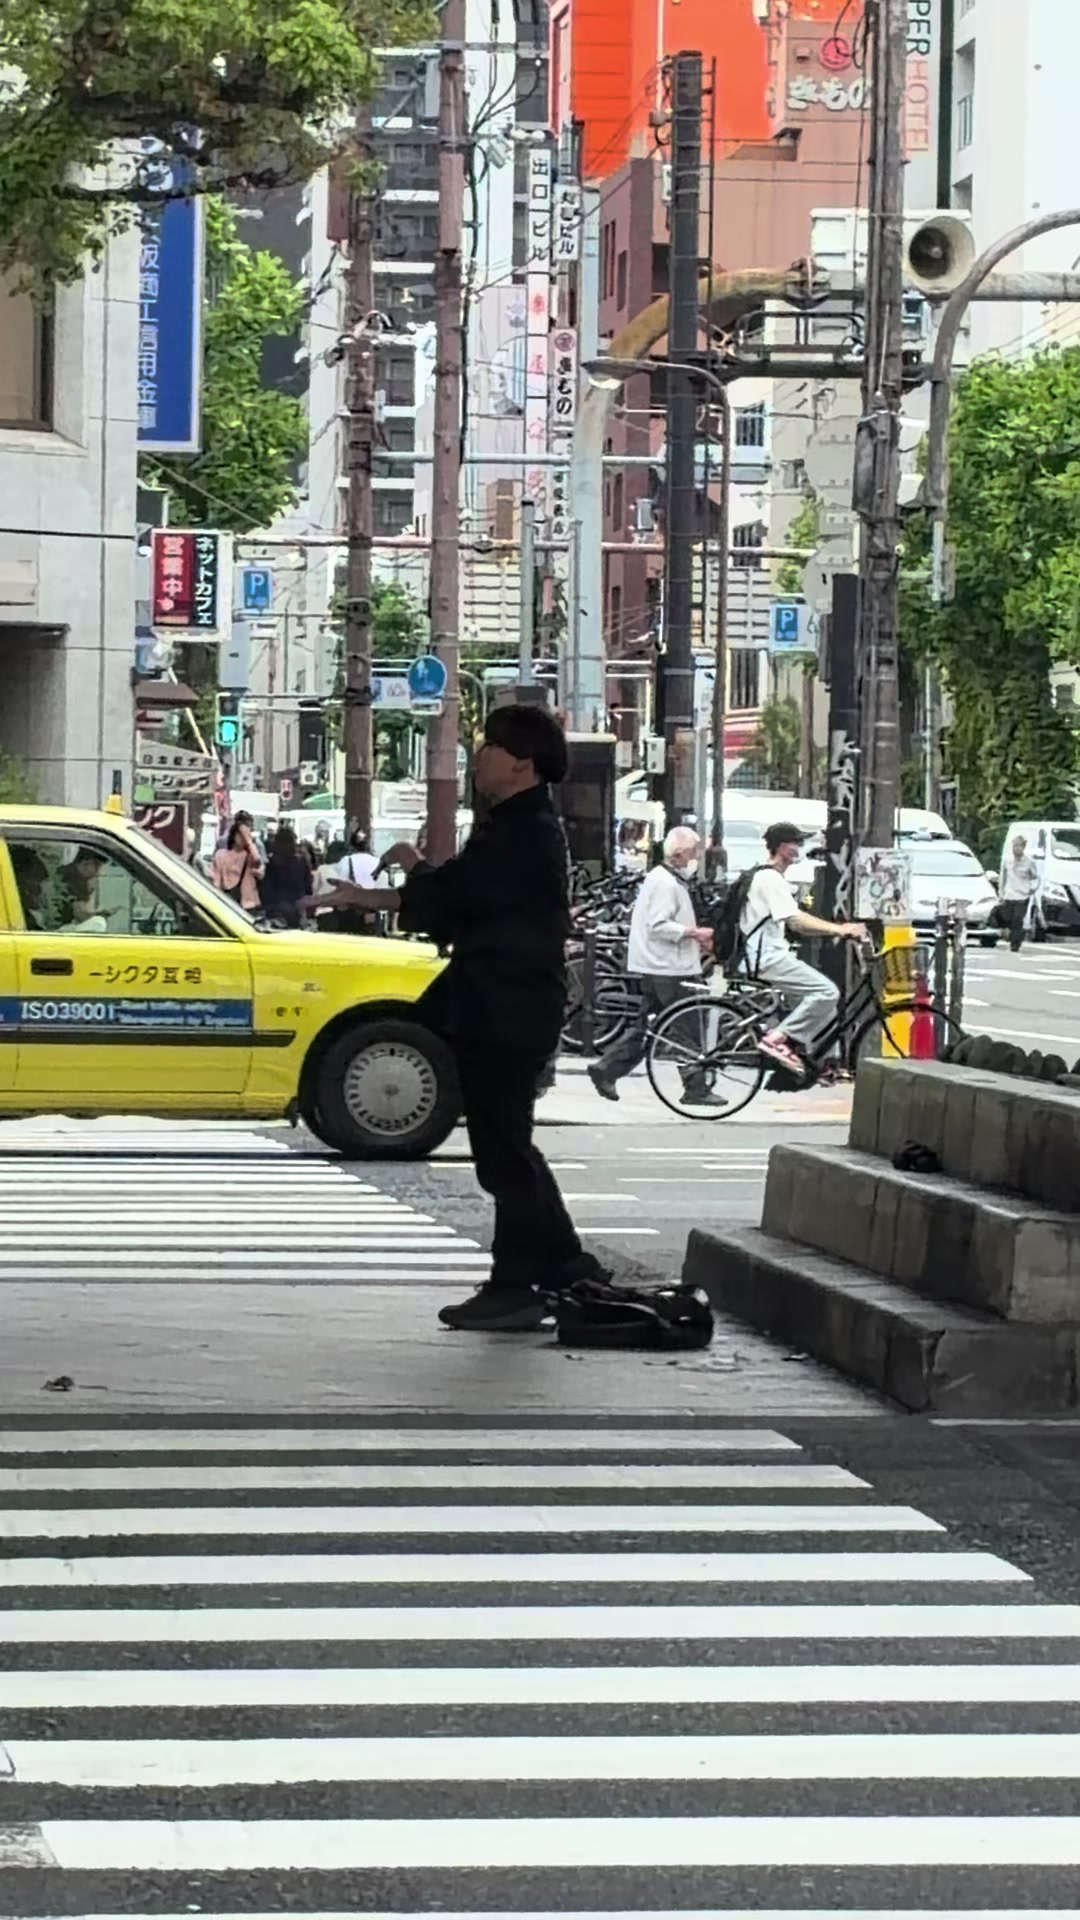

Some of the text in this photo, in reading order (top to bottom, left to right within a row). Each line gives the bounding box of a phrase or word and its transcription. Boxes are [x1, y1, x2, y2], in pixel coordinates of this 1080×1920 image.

[138, 213, 161, 429] 阪商工信用金庫
[250, 573, 265, 595] P
[781, 610, 794, 630] P
[21, 1002, 115, 1019] ISO39001
